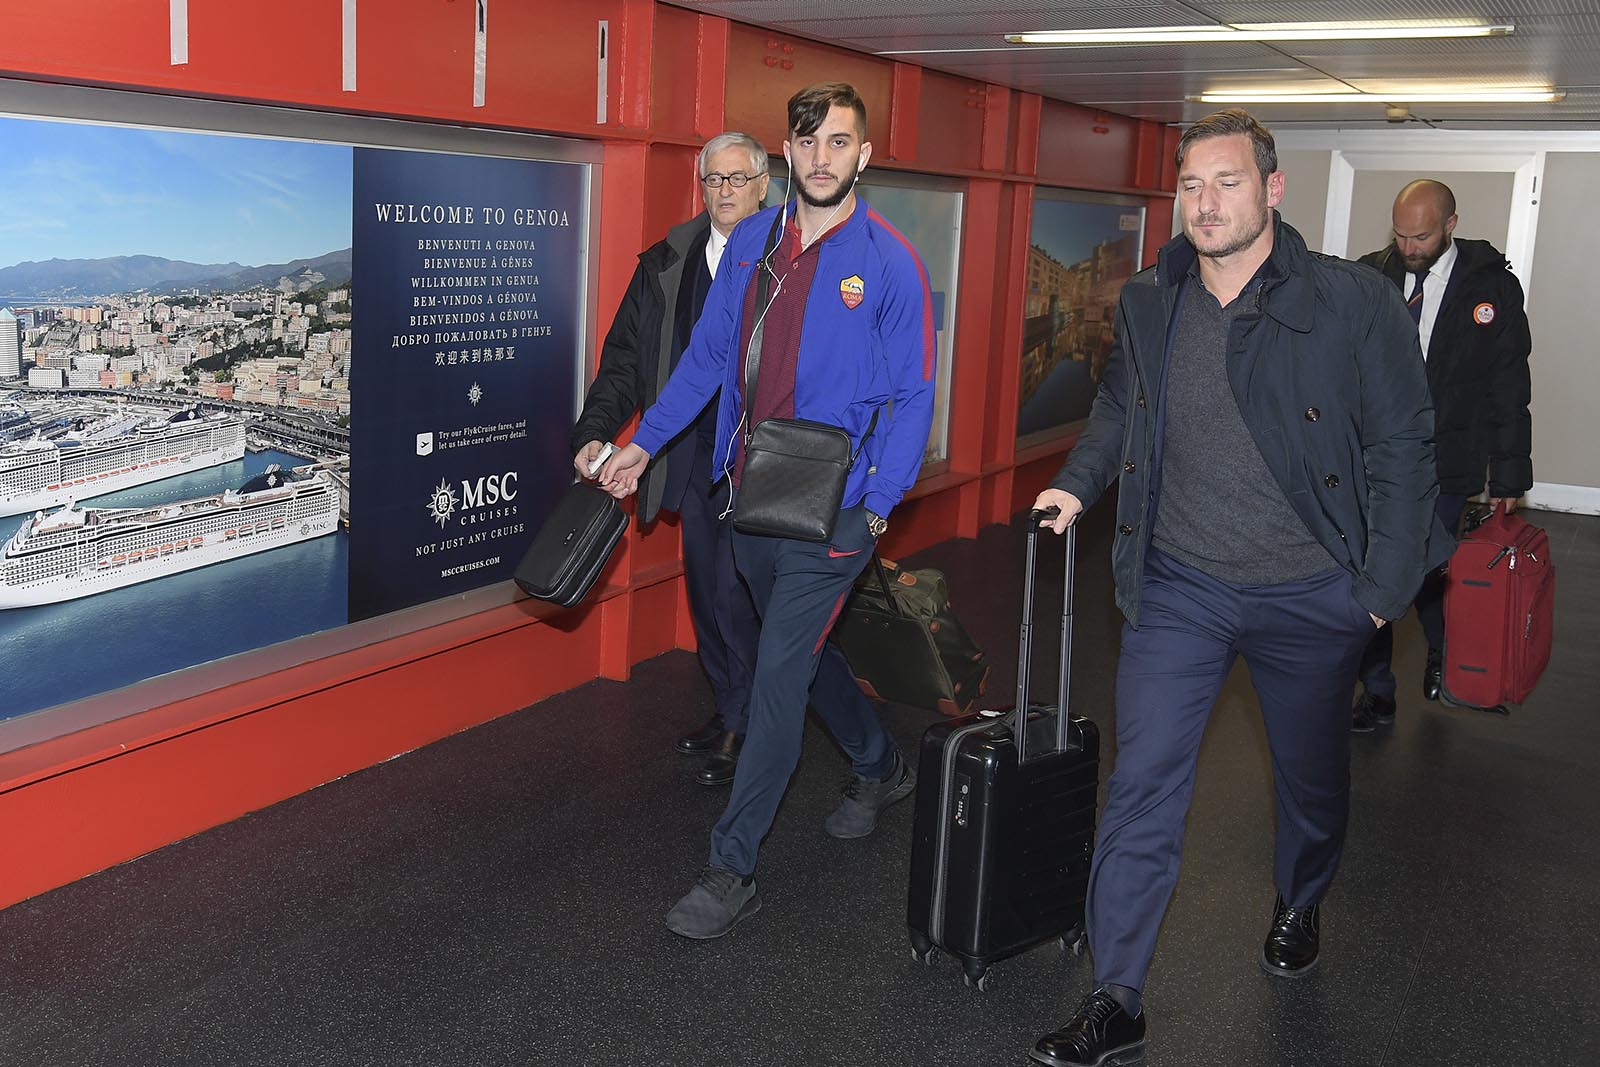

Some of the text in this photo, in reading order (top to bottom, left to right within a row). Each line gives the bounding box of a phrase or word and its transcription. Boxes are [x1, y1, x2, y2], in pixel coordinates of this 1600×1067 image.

[375, 203, 569, 226] WELCOME TO GENOA
[418, 239, 536, 250] BENVENUTI A GENOVA
[424, 258, 487, 269] BIENVENUE
[491, 255, 497, 268] À
[411, 275, 539, 288] WILLKOMMEN IN GENUA
[414, 291, 537, 307] BEM-VINDOS A GÉNOVA
[410, 309, 539, 326] BIENVENIDOS A GÉNOVA
[392, 326, 552, 348] ДОБРО ПОЖАЛОВАТЬ В ГЕНУЕ
[434, 346, 516, 366] 欢迎来到热那亚
[438, 431, 450, 440] Try
[463, 422, 497, 436] Fly&Cruise
[497, 422, 514, 431] fares,
[515, 419, 526, 428] and
[438, 441, 447, 450] let
[457, 438, 471, 447] take
[471, 437, 484, 445] care
[485, 434, 493, 442] of
[493, 434, 508, 442] every
[509, 429, 528, 439] detail.
[460, 471, 518, 511] MSC
[460, 505, 518, 526] CRUISES
[415, 522, 525, 557] NOT JUST ANY CRUISE
[441, 556, 500, 578] MSCCRUISES.COM
